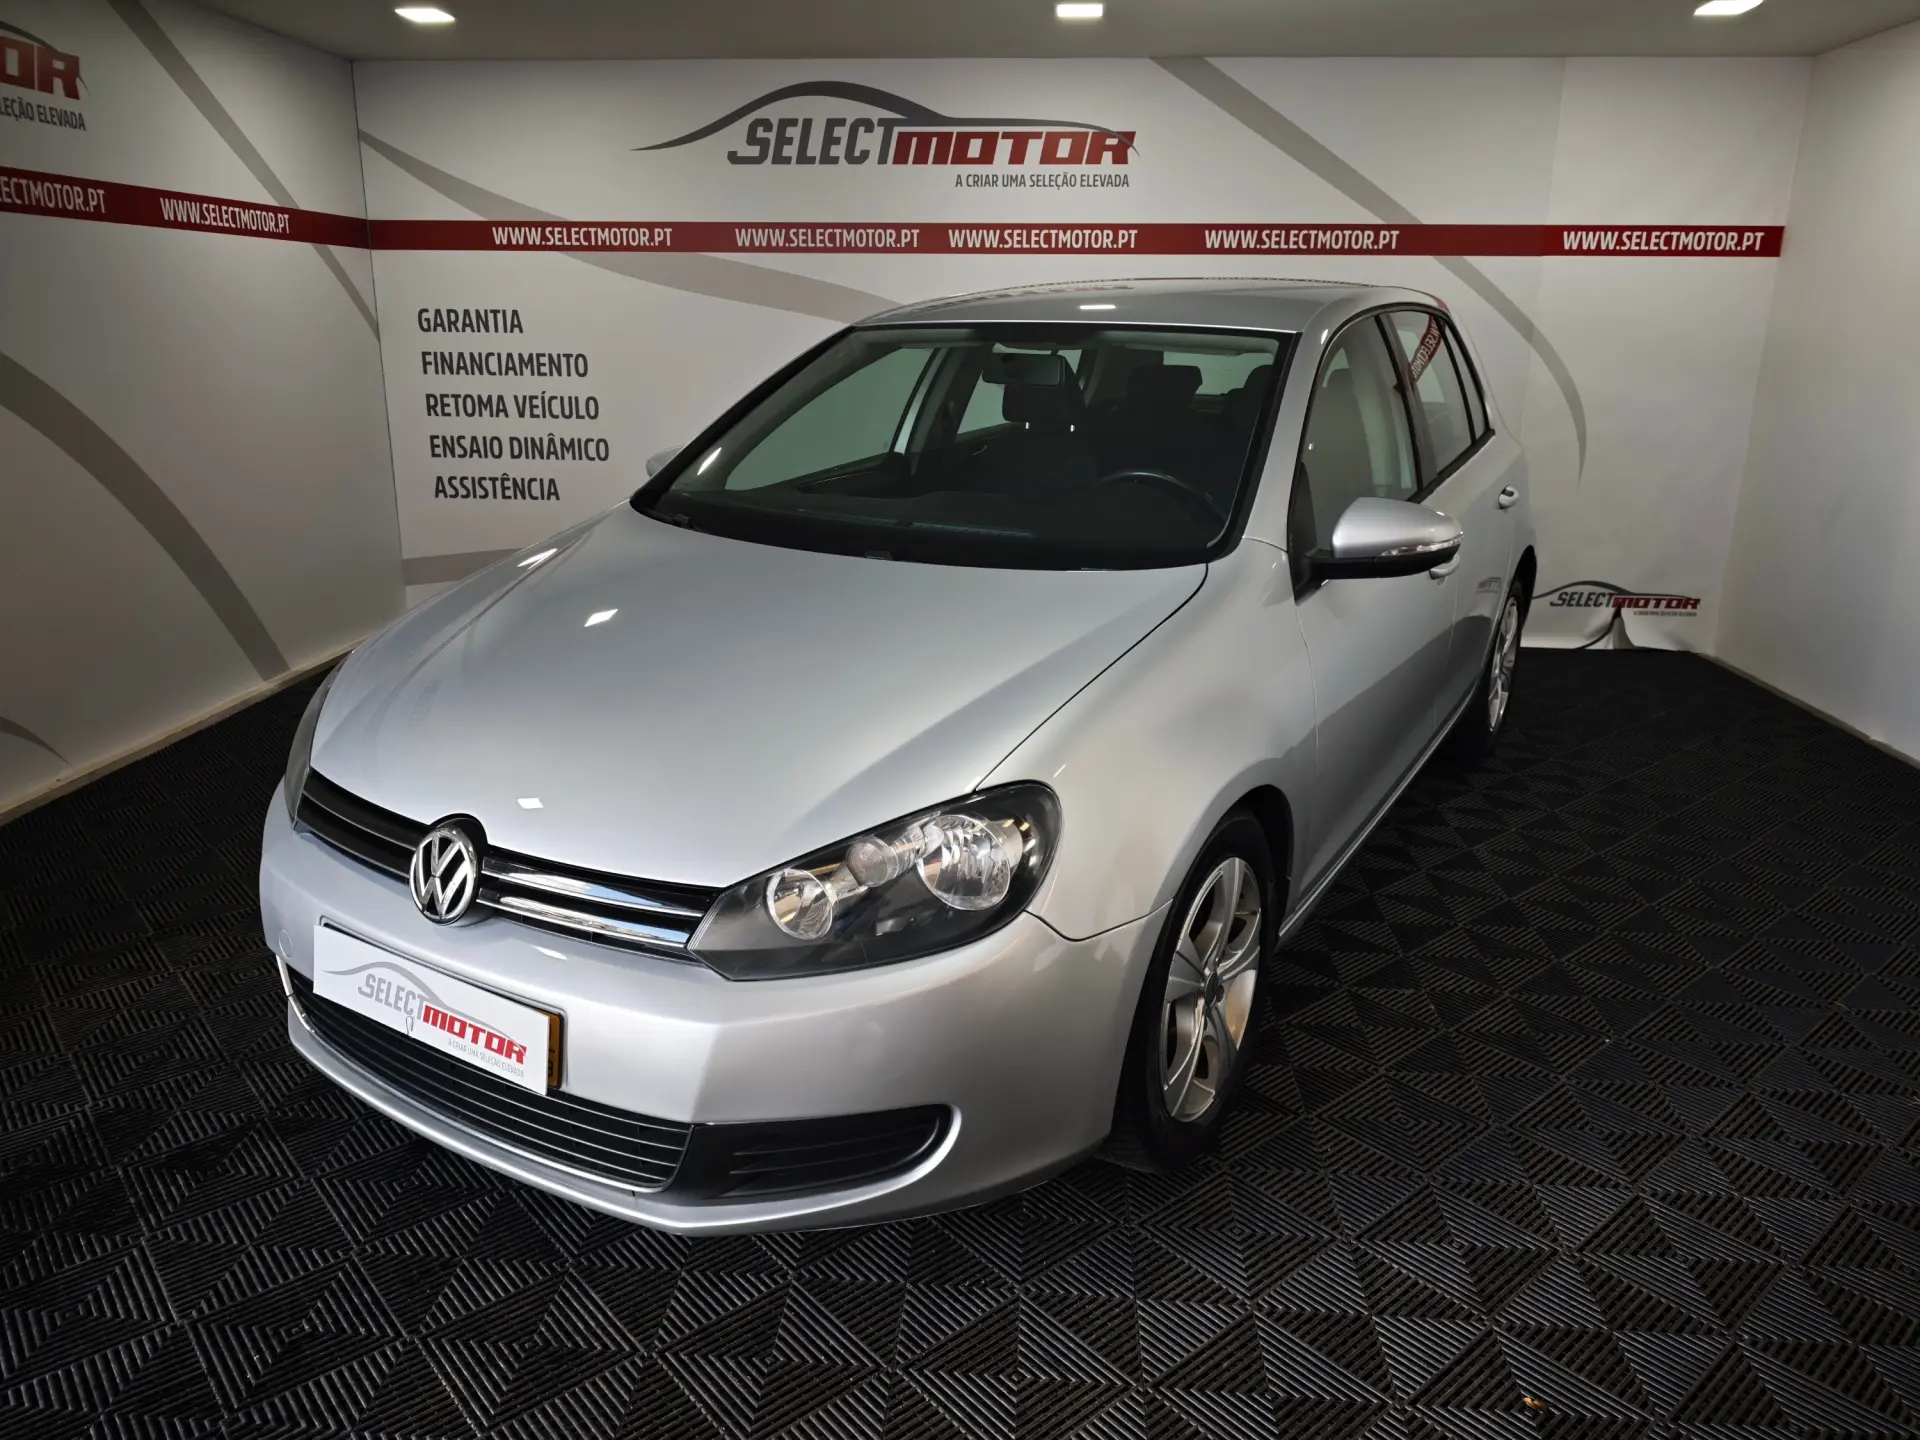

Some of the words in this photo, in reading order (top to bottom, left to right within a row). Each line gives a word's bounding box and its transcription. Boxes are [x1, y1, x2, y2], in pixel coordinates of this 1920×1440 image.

[36, 104, 86, 131] ELEVADA
[727, 117, 1137, 165] SELECTMOTOR
[0, 175, 106, 214] ECTMOTOR.PT
[955, 174, 963, 187] A
[966, 174, 999, 187] CRIAR
[1002, 174, 1026, 187] UMA
[1029, 172, 1077, 190] SELEÇÃO
[1079, 174, 1130, 187] ELEVADA
[160, 197, 291, 234] WWW.SELECTMOTOR.PT
[491, 226, 673, 247] WWW.SELECTMOTOR.PT
[734, 228, 920, 248] WWW.SELECTMOTOR.PT
[948, 229, 1138, 249] WWW.SELECTMOTOR.PT
[1204, 229, 1400, 250] WWW.SELECTMOTOR.PT
[1563, 230, 1765, 251] WWW.SELECTMOTOR.PT
[417, 307, 524, 334] GARANTIA
[421, 351, 589, 378] FINANCIAMENTO
[425, 393, 509, 419] RETOMA
[513, 390, 600, 420] VEÍCULO
[429, 434, 503, 460] ENSAIO
[508, 432, 610, 462] DINÂMICO
[434, 472, 561, 501] ASSISTÊNCIA
[357, 973, 528, 1065] SELECTMOTOR
